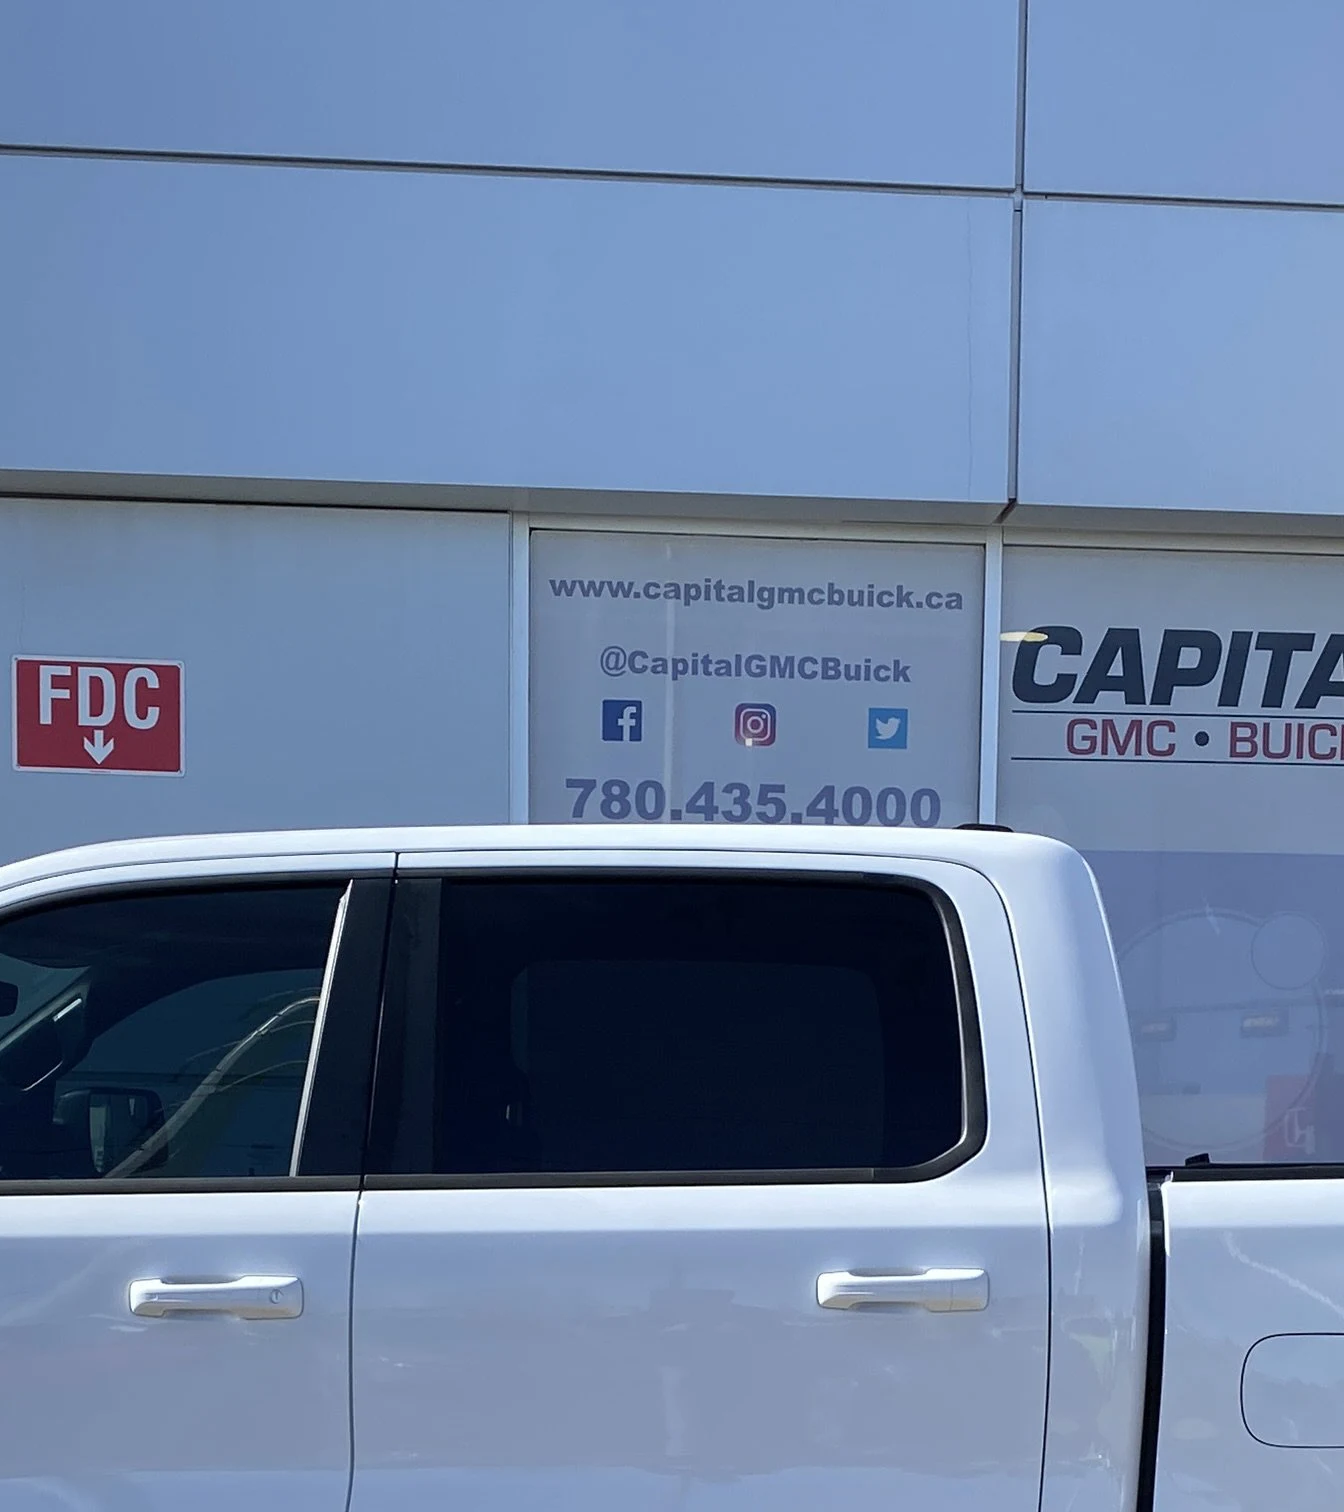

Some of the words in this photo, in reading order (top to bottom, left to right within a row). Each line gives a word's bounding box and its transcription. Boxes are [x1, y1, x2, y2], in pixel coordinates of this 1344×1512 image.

[549, 578, 963, 611] www.capitalgmcbuick.ca
[600, 646, 911, 683] @CapitalGMCBuick
[39, 664, 160, 730] FDC
[1066, 718, 1176, 757] GMC
[565, 778, 942, 828] 780.435.4000
